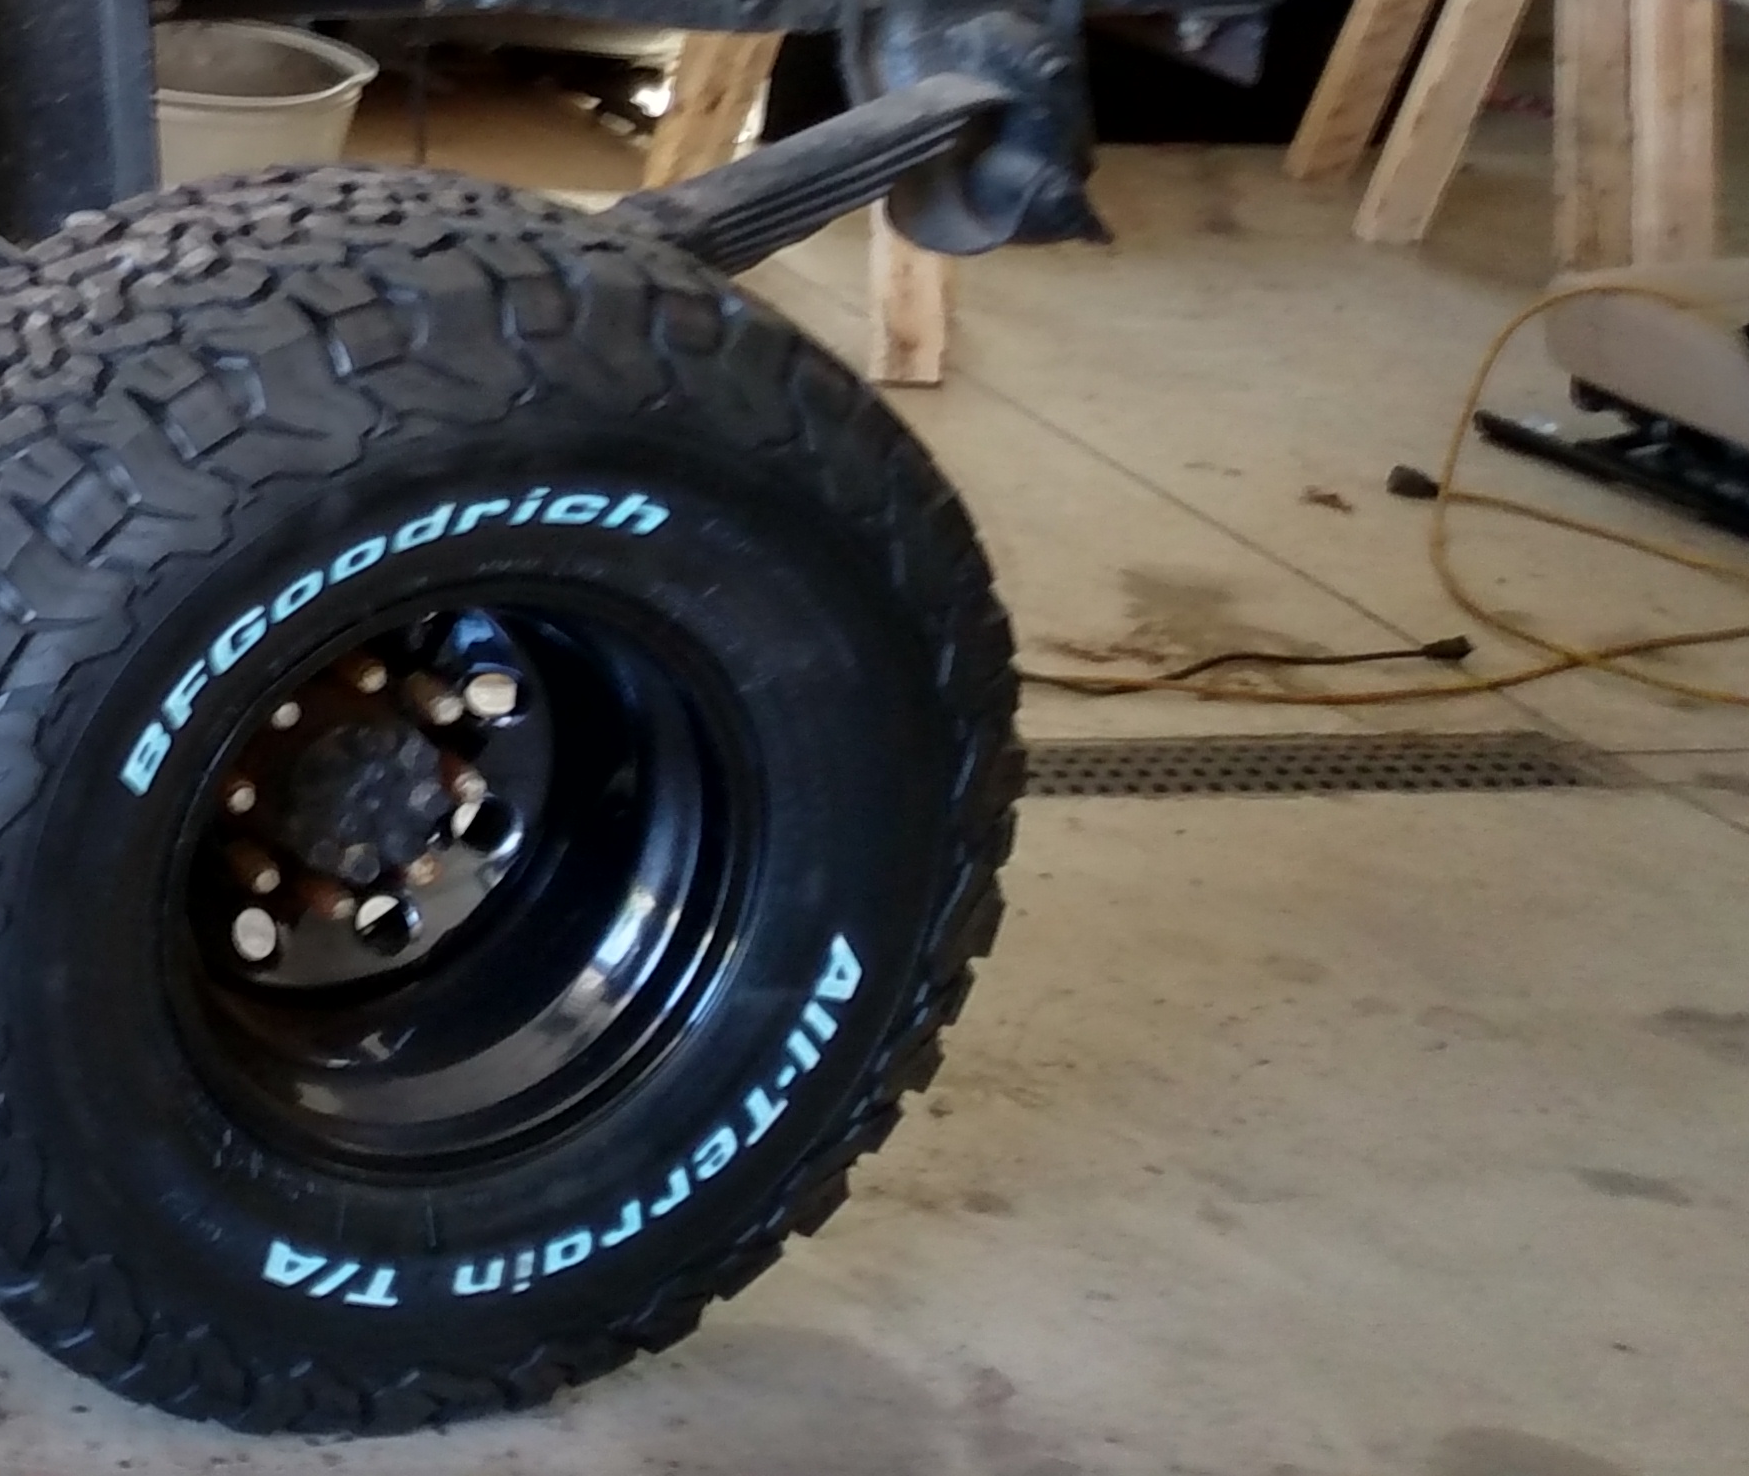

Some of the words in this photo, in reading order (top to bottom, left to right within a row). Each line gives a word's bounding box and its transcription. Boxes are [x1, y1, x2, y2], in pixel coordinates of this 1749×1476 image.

[118, 487, 671, 797] BFGoodrich
[452, 933, 863, 1297] All-Terrain
[262, 1239, 399, 1309] T/A
